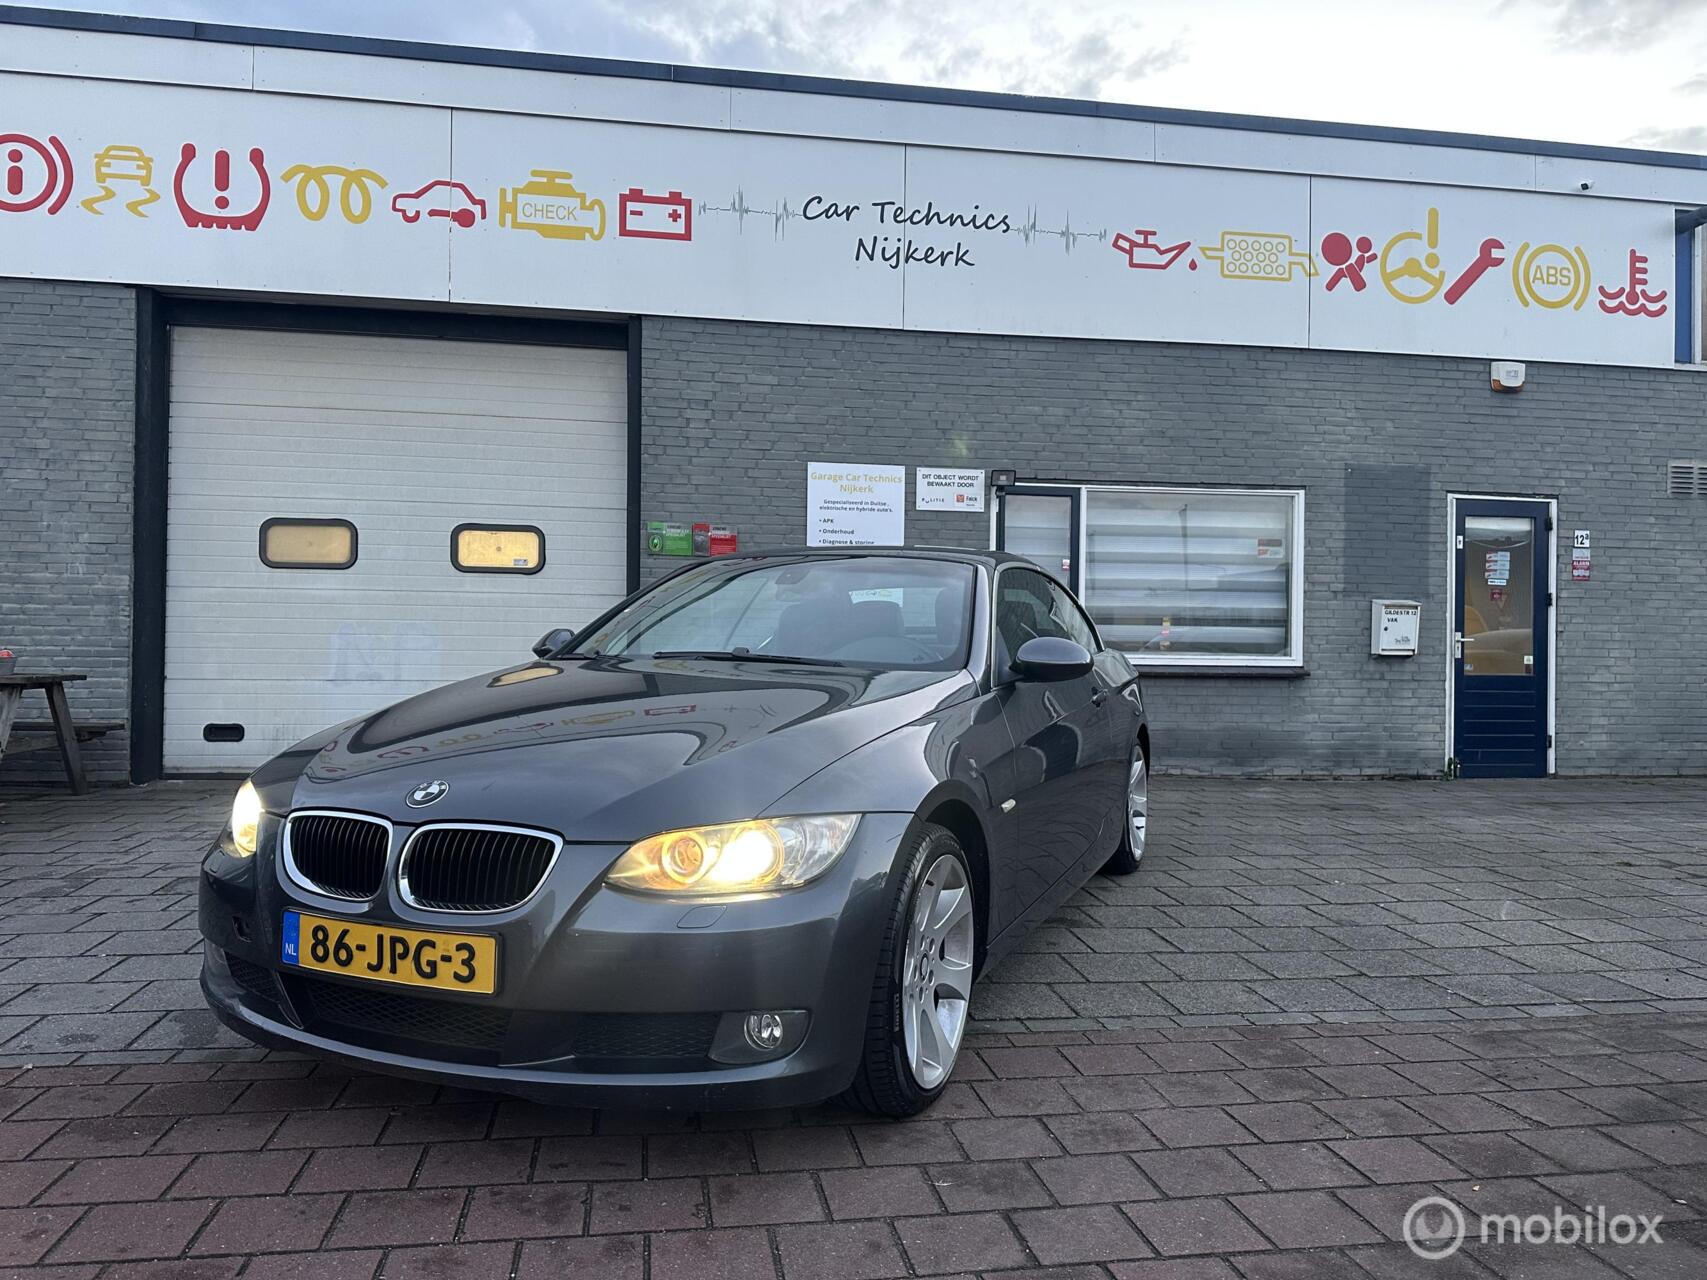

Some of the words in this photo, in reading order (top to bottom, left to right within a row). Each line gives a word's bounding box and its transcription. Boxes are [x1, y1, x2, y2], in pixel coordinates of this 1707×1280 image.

[522, 202, 577, 221] CHECK
[802, 195, 859, 221] Car
[871, 201, 1011, 233] Technics
[855, 236, 975, 269] Nijkerk
[1531, 265, 1571, 286] ABS
[811, 472, 844, 483] Garage
[845, 473, 861, 482] Car
[863, 474, 903, 483] Technics
[840, 484, 874, 494] Nijkerk
[285, 942, 297, 956] NL
[310, 924, 476, 983] 86-JPG-3
